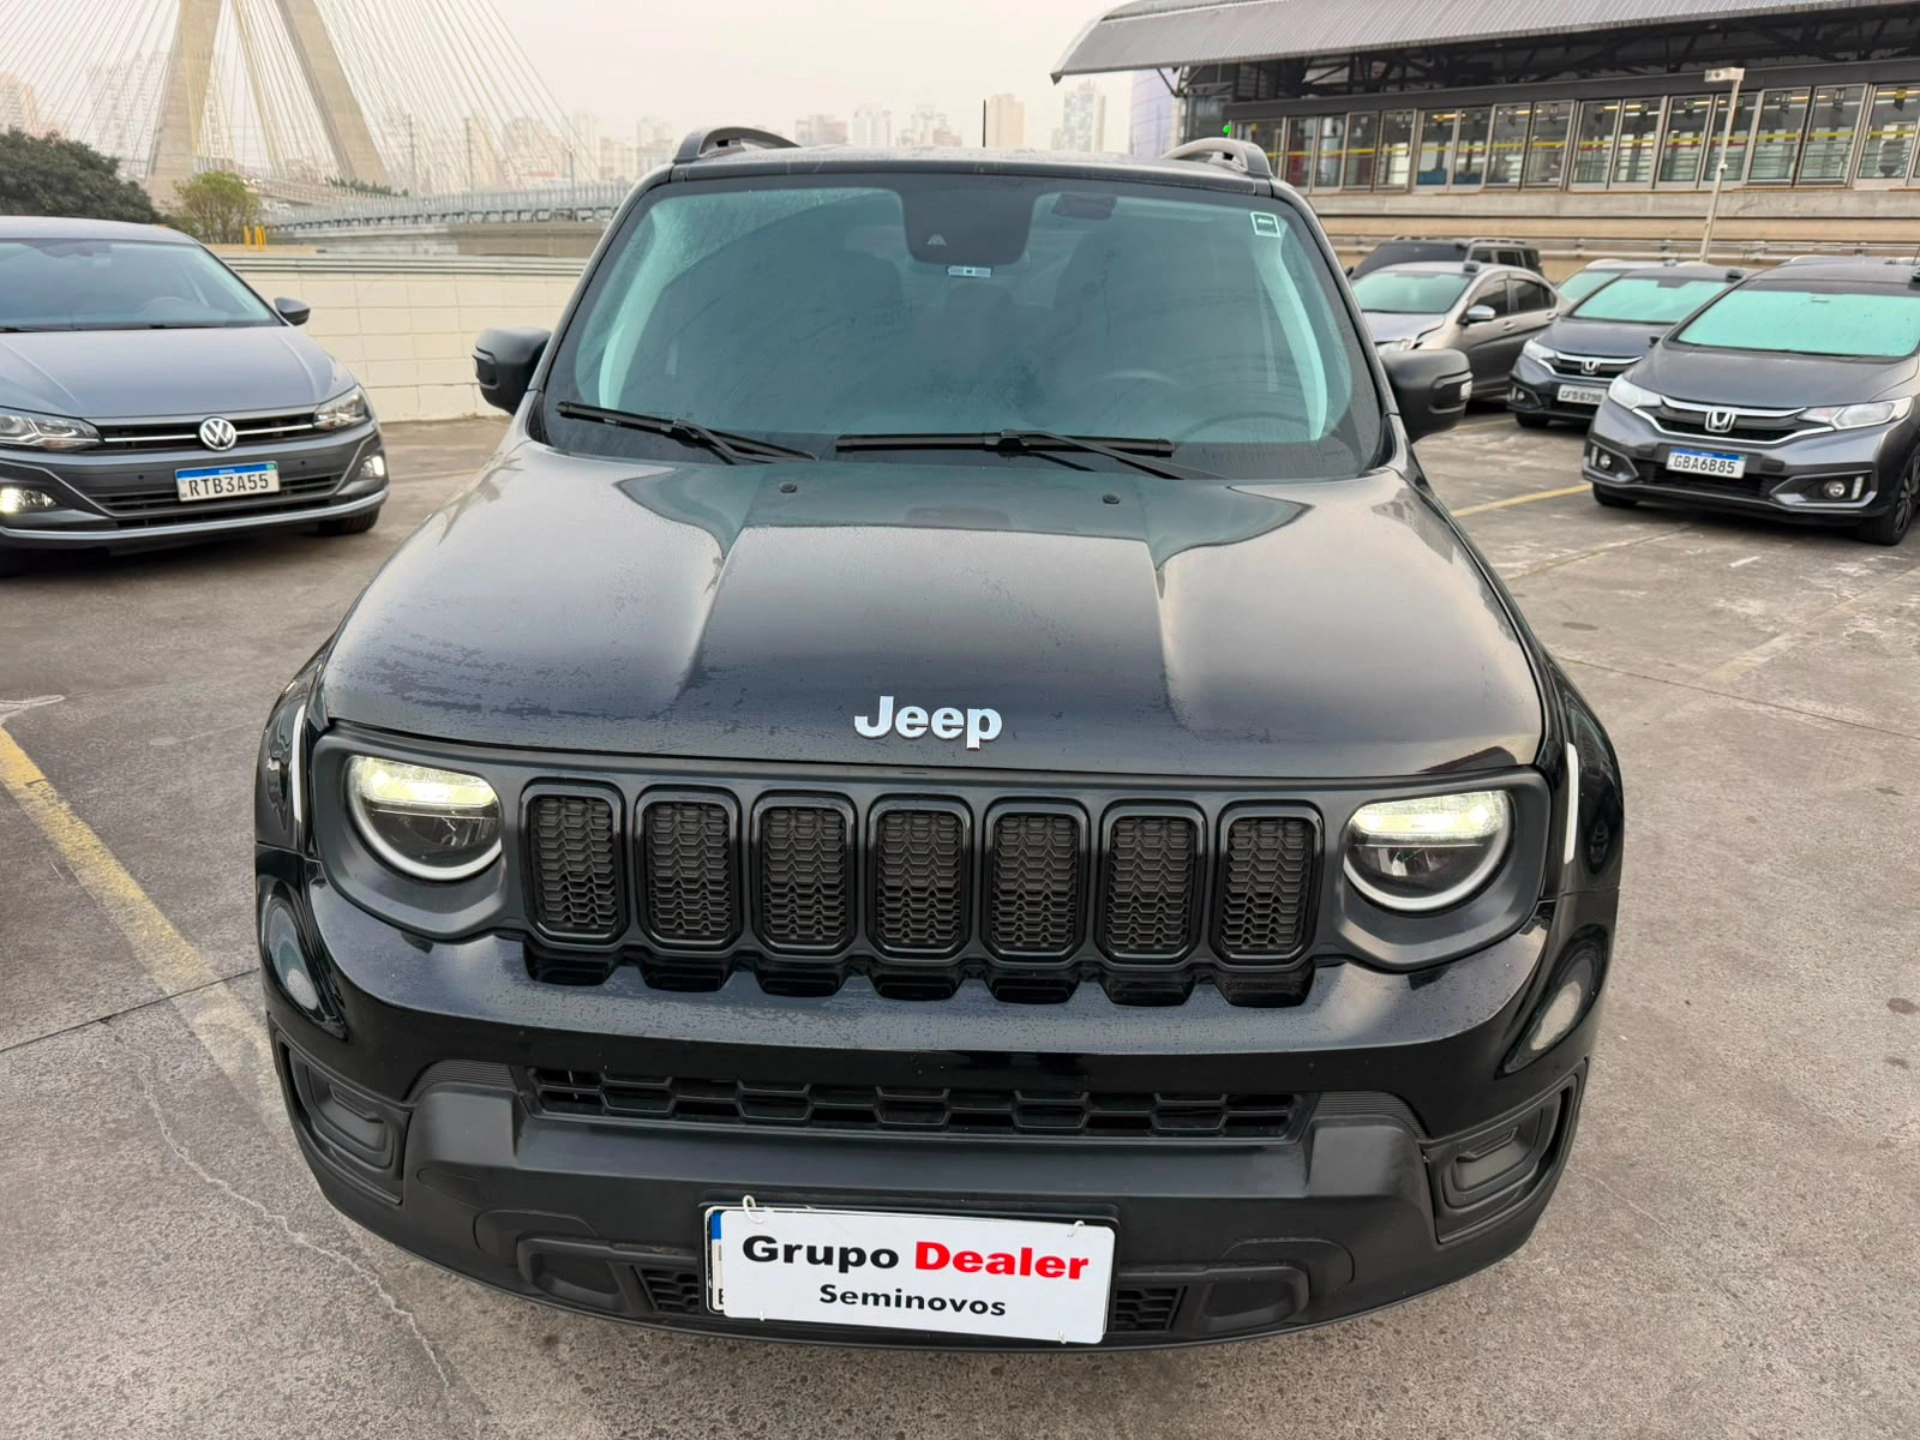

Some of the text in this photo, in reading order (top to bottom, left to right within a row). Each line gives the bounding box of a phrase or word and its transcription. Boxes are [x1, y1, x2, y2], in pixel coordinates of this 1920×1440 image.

[1673, 455, 1735, 475] GBA6B85
[188, 473, 269, 497] RTB3A55
[854, 695, 1003, 751] Jeep
[742, 1234, 1089, 1280] Grupo Dealer
[819, 1284, 1006, 1317] Seminovos
